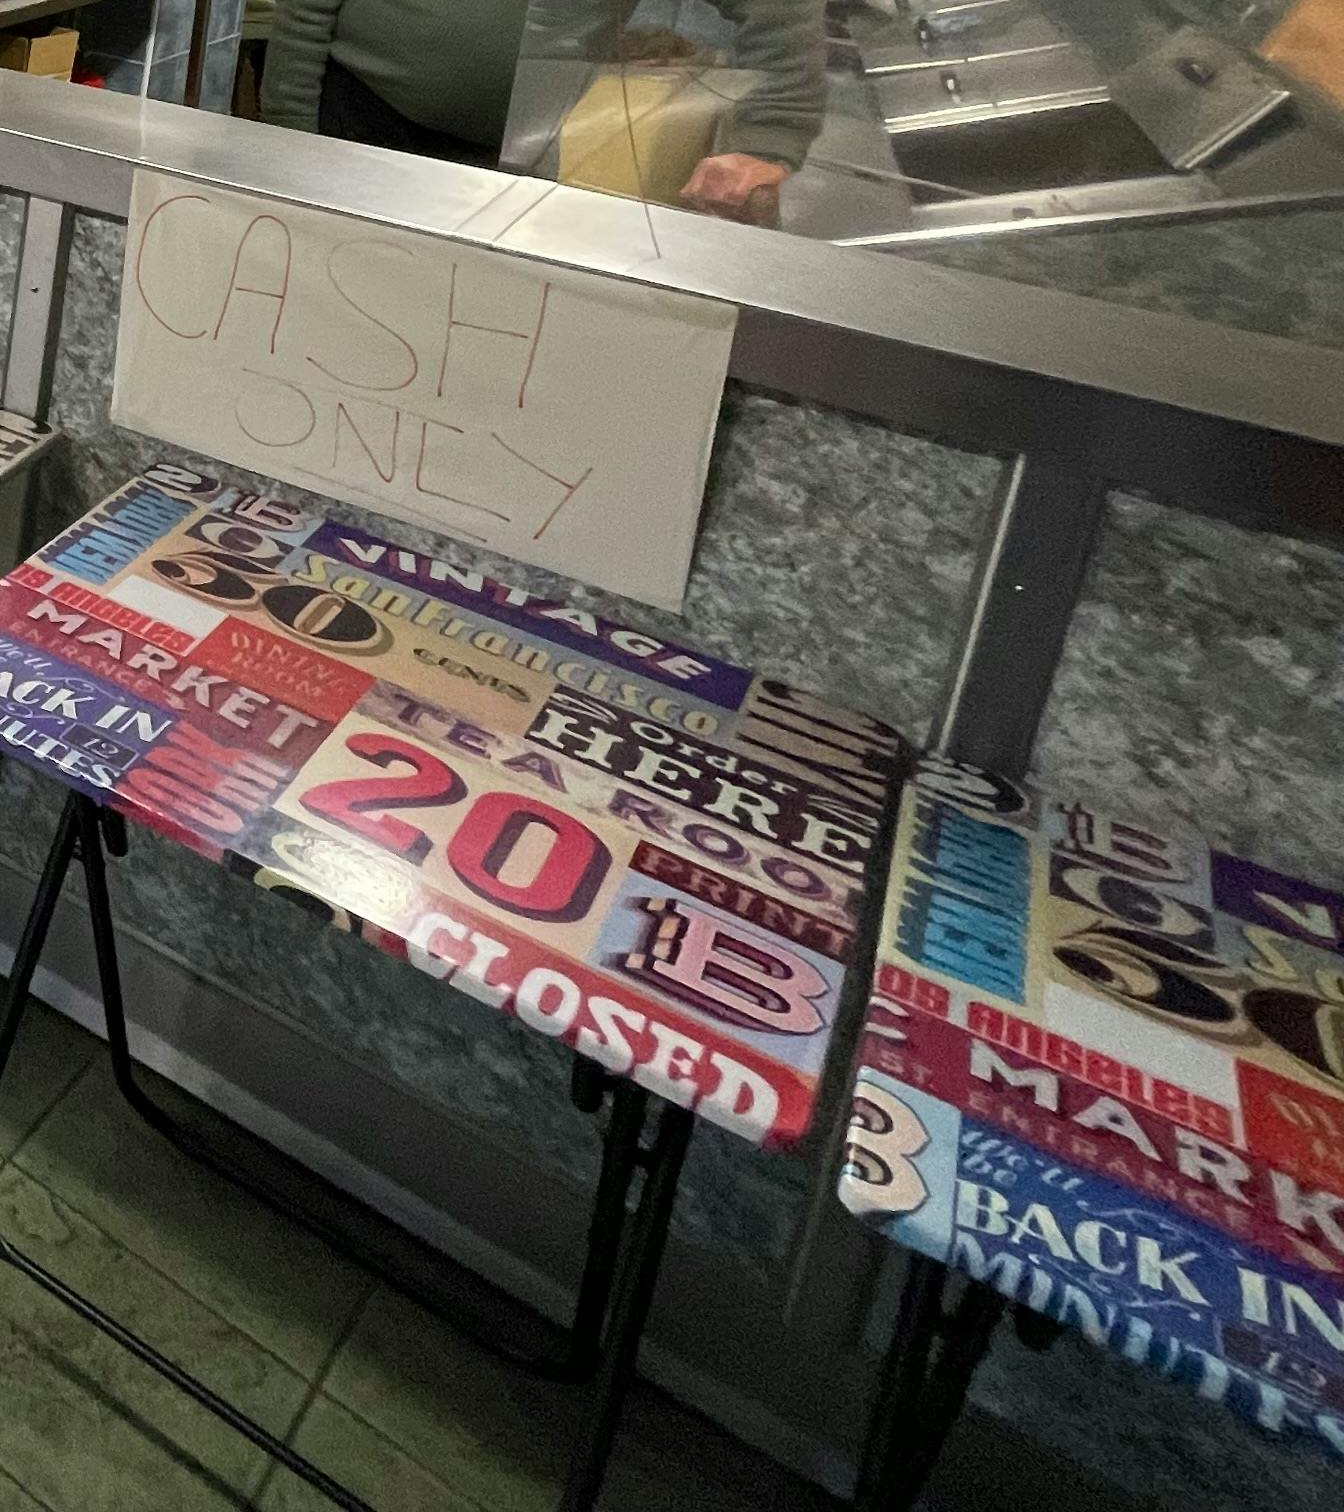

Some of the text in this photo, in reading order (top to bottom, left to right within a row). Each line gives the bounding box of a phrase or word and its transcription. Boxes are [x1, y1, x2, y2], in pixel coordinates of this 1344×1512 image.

[135, 195, 553, 408] CASH
[234, 368, 595, 541] ONLY
[27, 599, 319, 751] MARKET
[334, 535, 714, 682] VINTAGE
[96, 705, 173, 742] IN
[393, 692, 568, 793] TEA
[531, 708, 871, 871] HERE
[630, 721, 799, 794] Order
[298, 731, 612, 923] 20
[639, 851, 848, 951] PRINT
[404, 910, 782, 1148] CLOSED
[954, 1179, 1210, 1306] BACK
